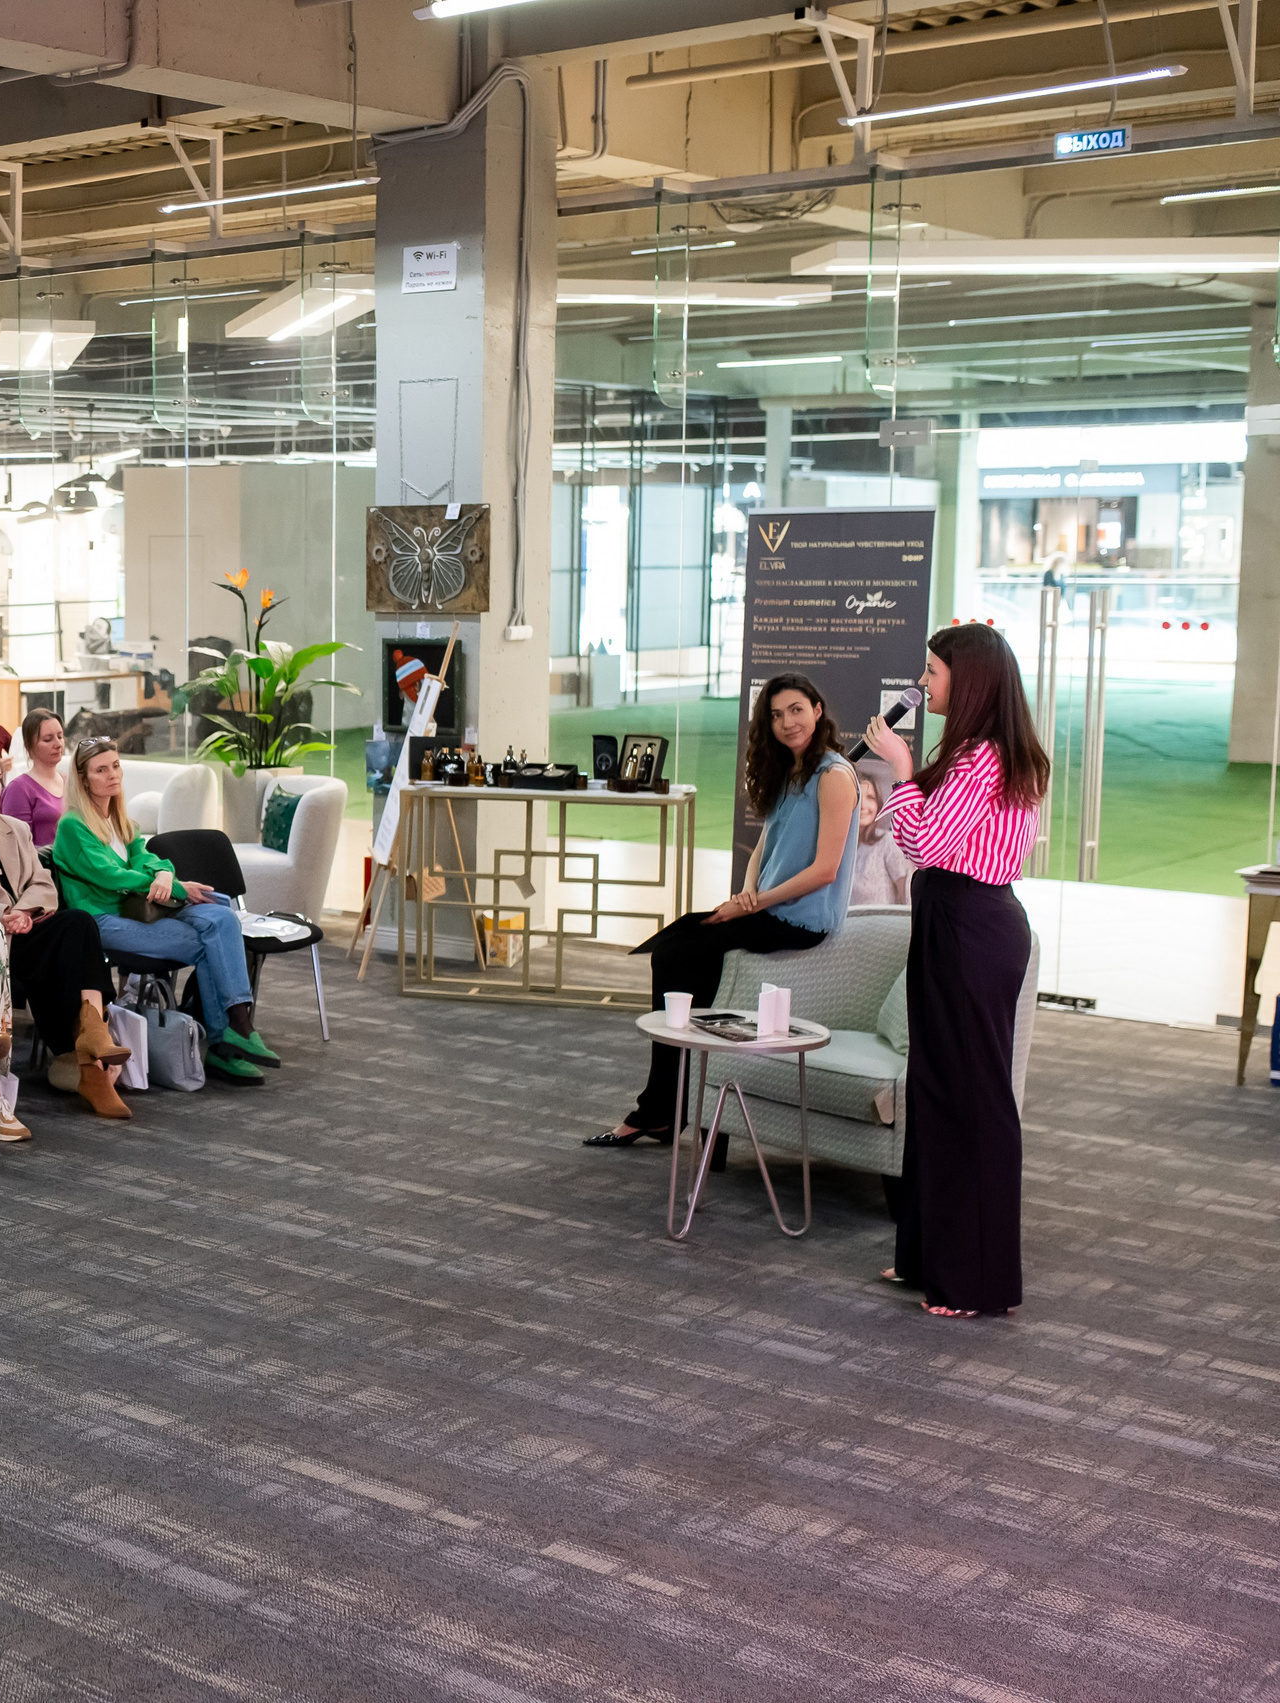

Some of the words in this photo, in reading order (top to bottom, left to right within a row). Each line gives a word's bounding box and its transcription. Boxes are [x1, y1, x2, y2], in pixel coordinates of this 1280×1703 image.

[1057, 131, 1124, 154] ВЫХОД
[426, 251, 447, 260] Wi-Fi
[790, 541, 808, 549] ТВОЙ
[845, 594, 897, 615] Organic
